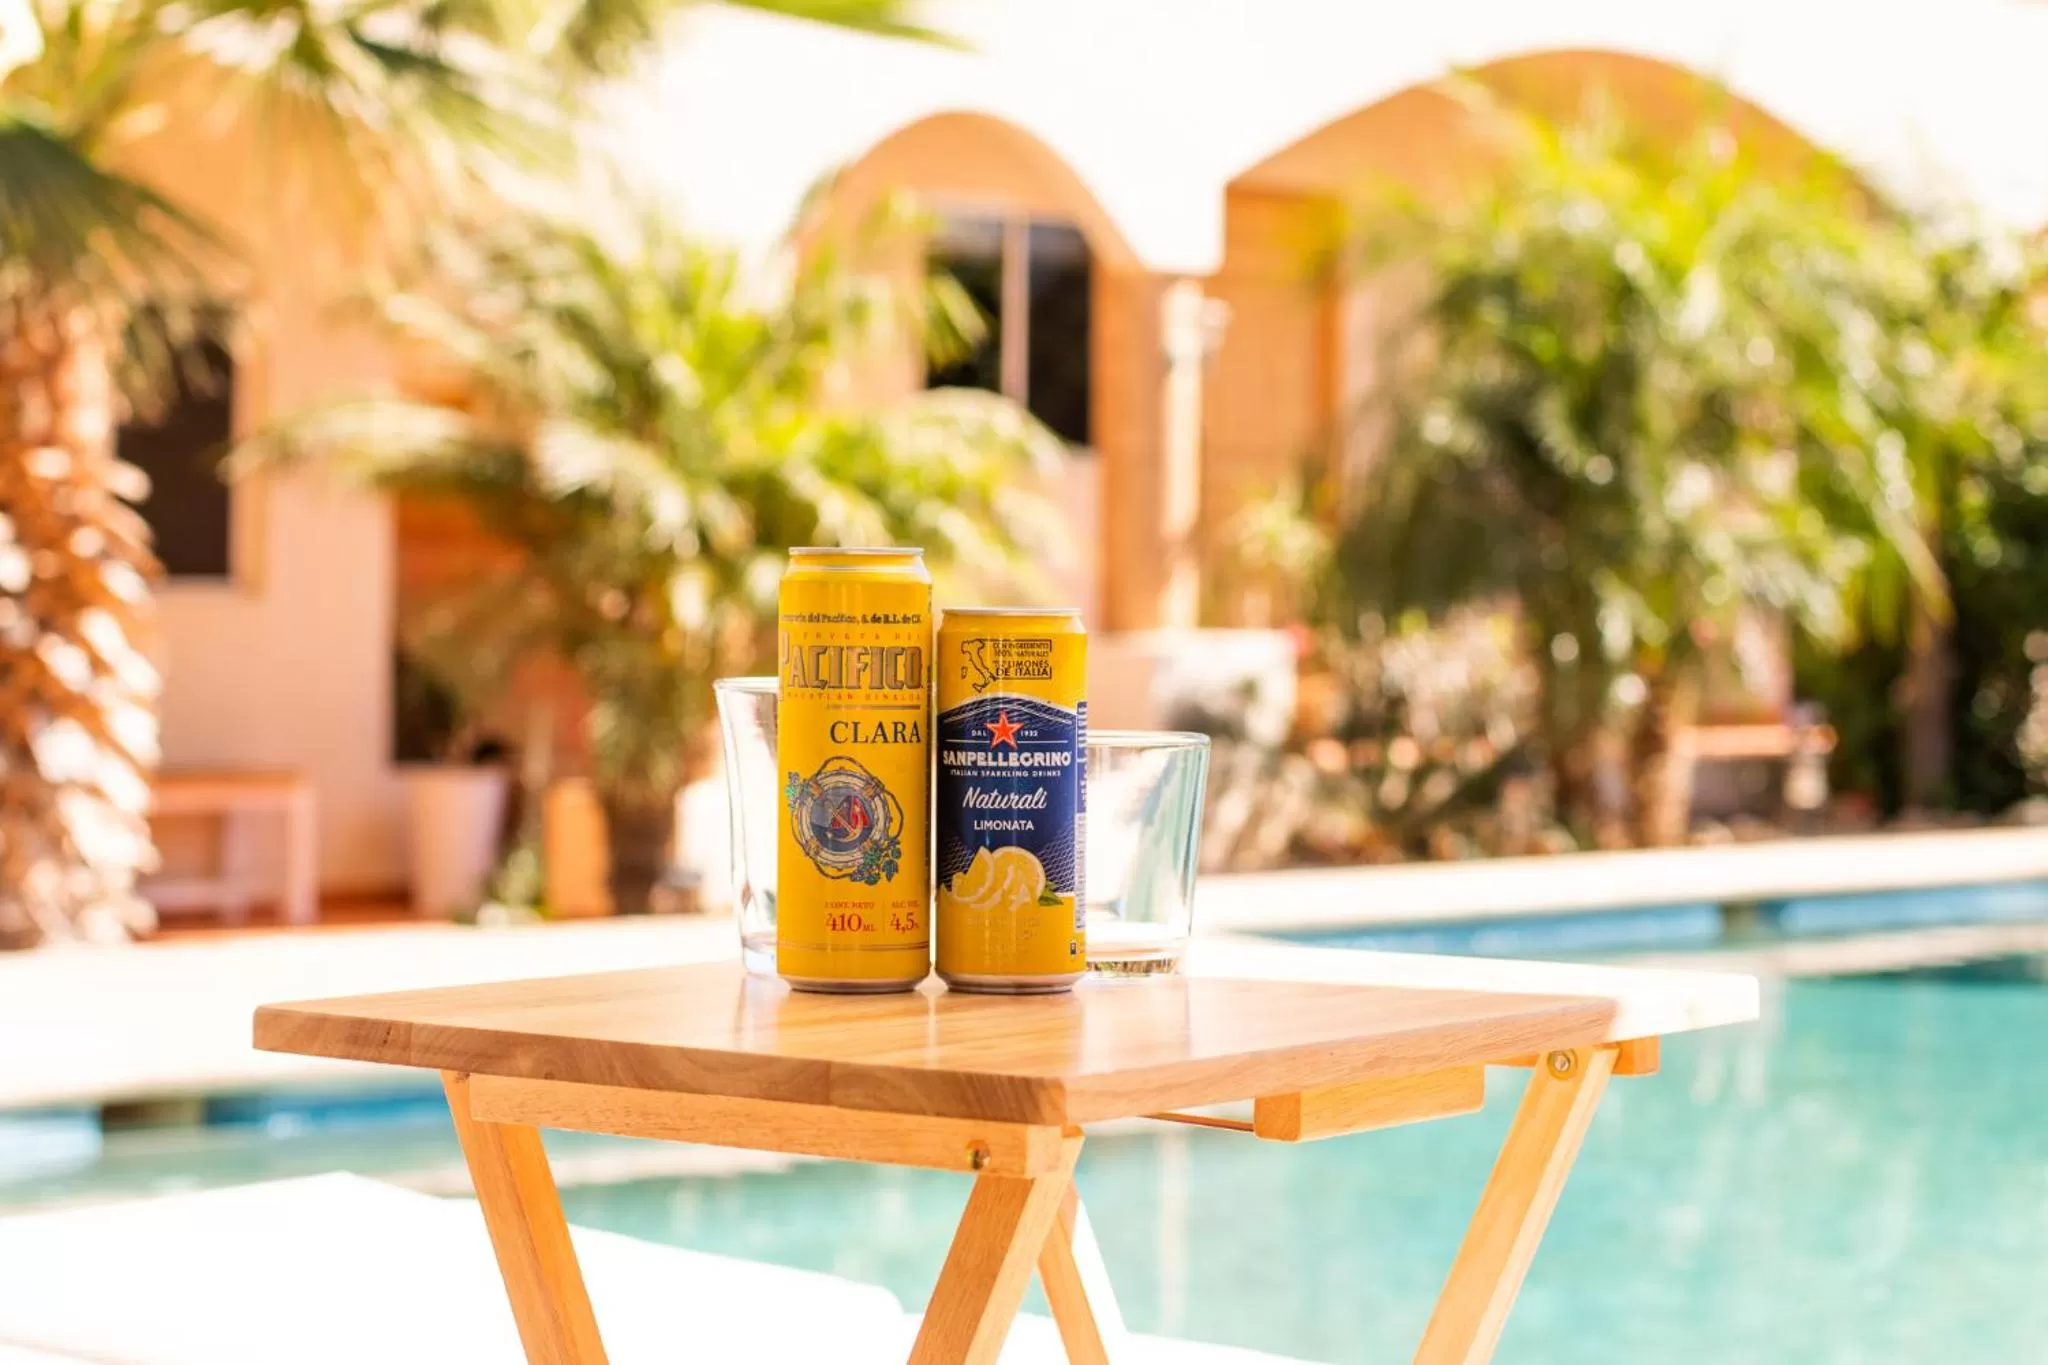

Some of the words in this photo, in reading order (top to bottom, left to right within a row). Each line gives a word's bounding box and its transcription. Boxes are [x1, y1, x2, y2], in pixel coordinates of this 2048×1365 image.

[778, 633, 923, 700] PACIFICO
[1007, 660, 1049, 669] LIMONES
[995, 668, 1011, 677] DE
[1015, 668, 1049, 677] ITALIA
[830, 720, 922, 744] CLARA
[971, 729, 986, 737] DAL
[942, 750, 1072, 767] SANPELLEGRINO
[950, 769, 978, 777] ITALIAN
[981, 769, 1029, 778] SPARKLING
[1032, 769, 1061, 777] DRINKS
[962, 786, 1048, 809] Naturali
[974, 820, 1035, 831] LIMONATA
